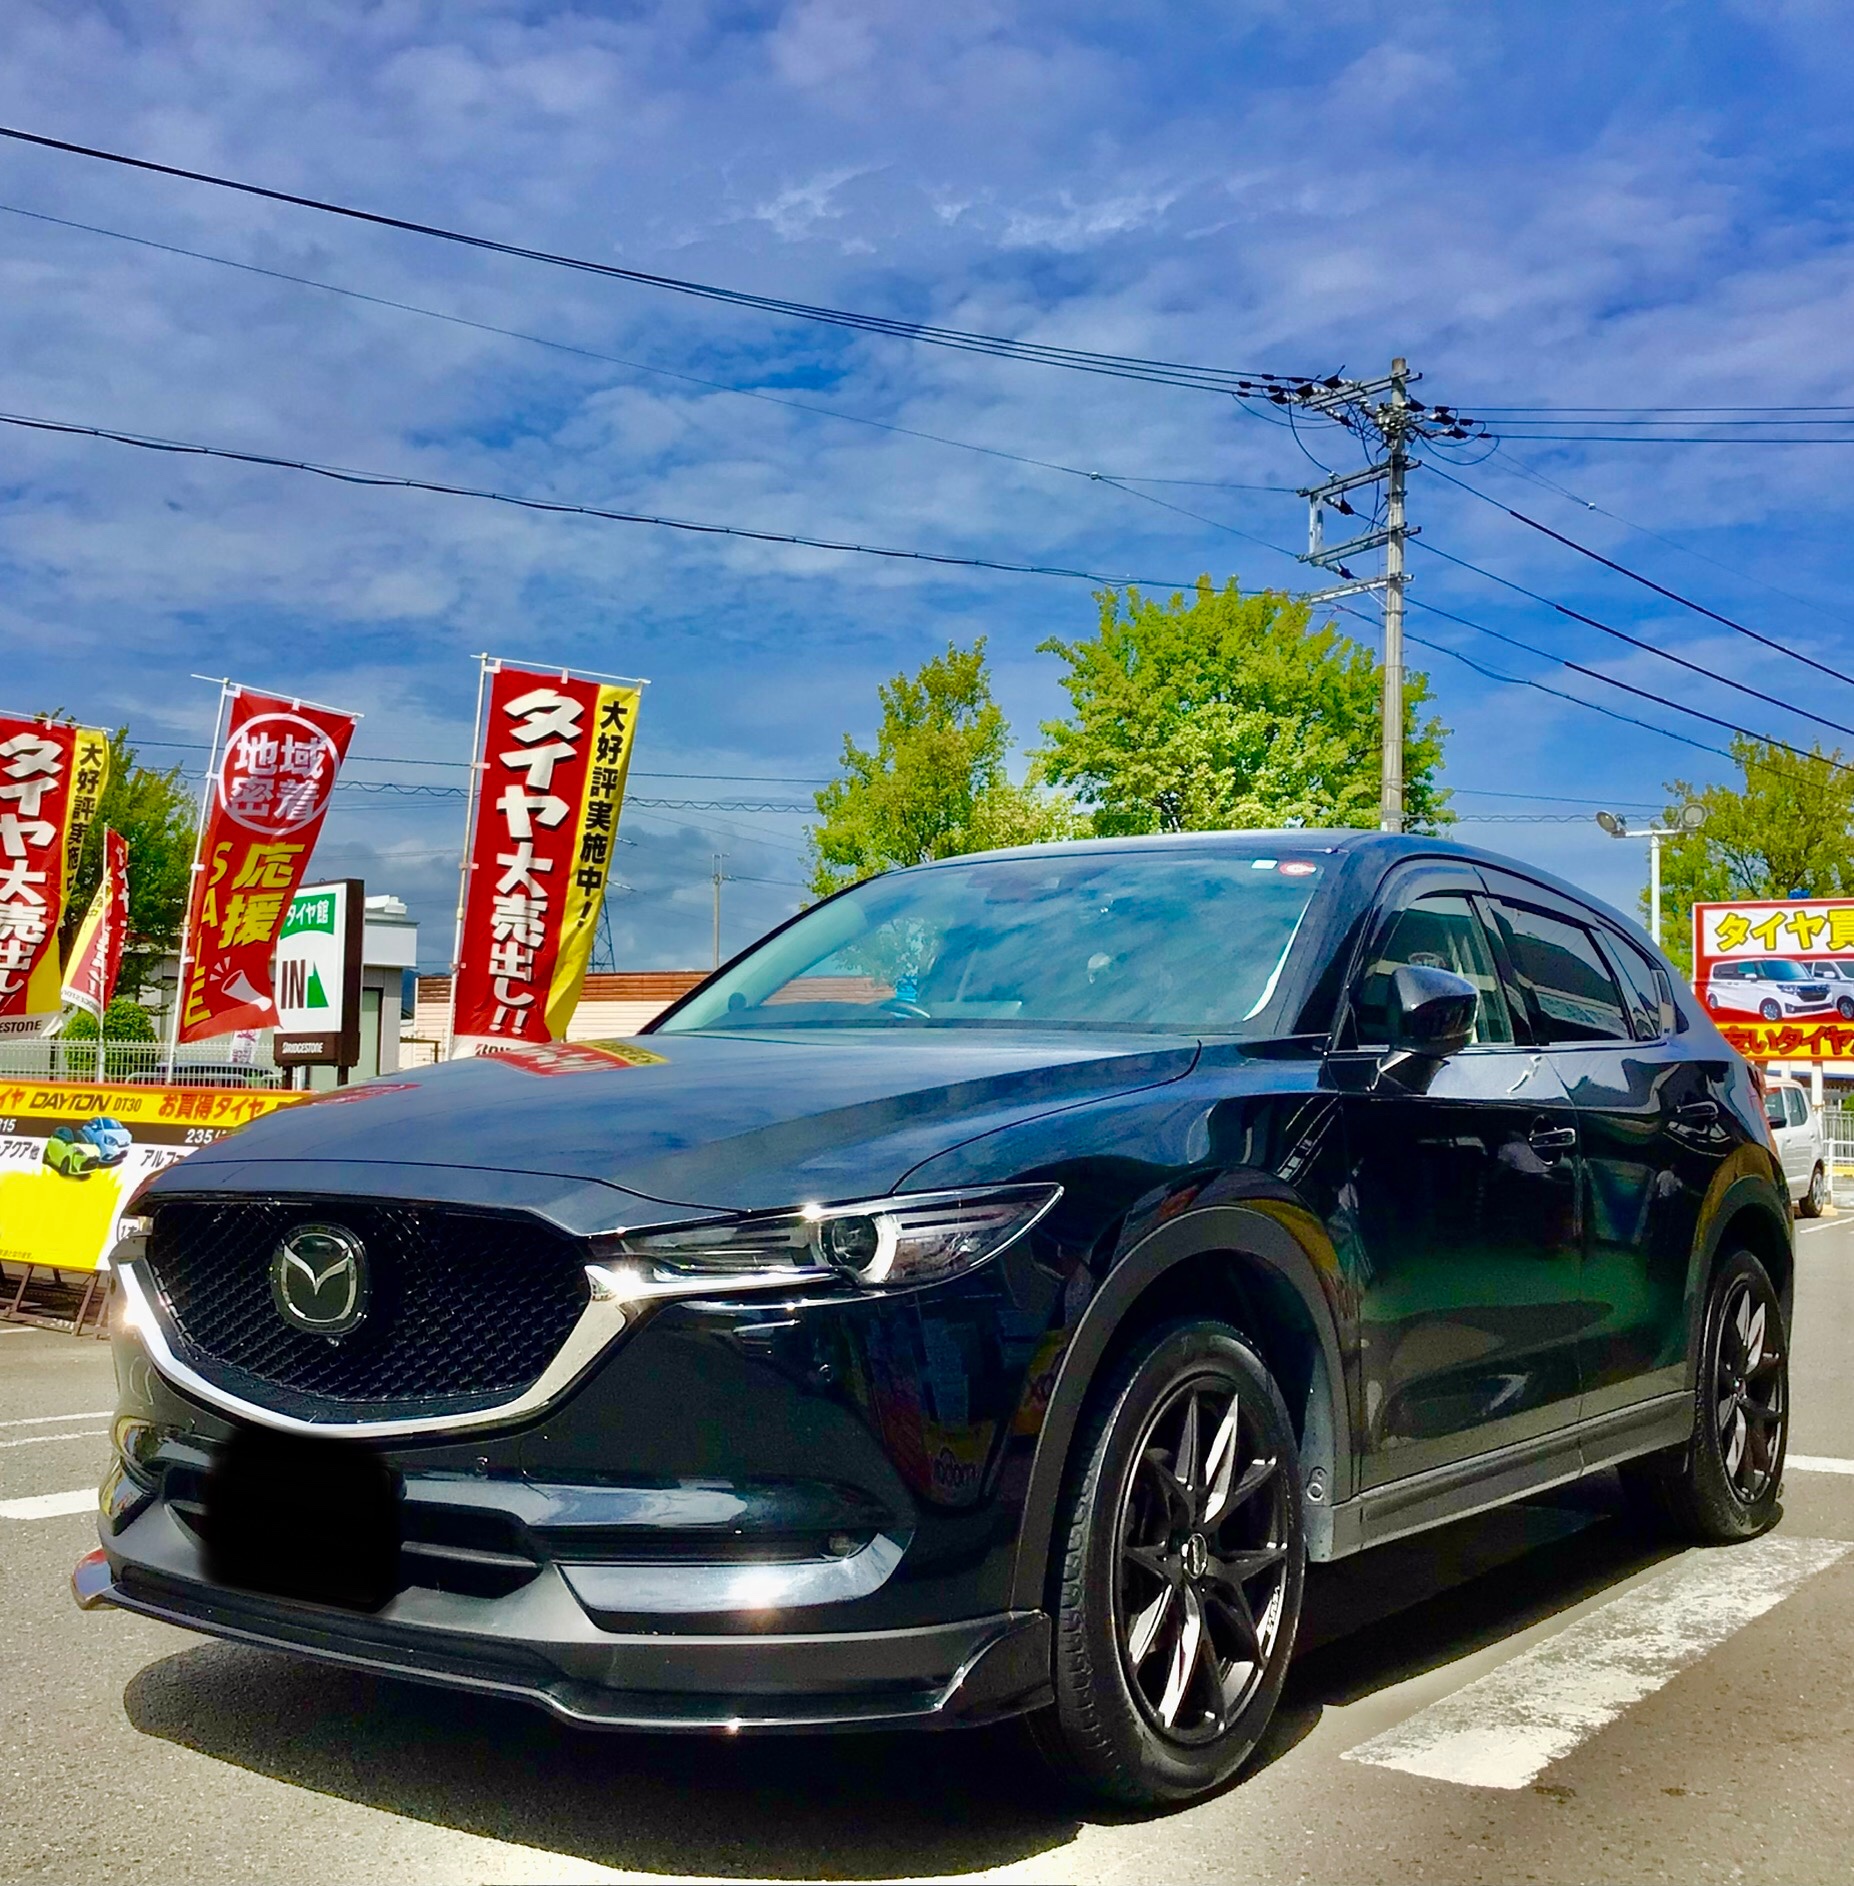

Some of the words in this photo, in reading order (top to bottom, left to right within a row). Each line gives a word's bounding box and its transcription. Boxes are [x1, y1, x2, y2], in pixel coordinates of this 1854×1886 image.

[234, 731, 327, 779] 地域
[230, 774, 320, 821] 密着
[576, 700, 628, 928] 大好評実施中!
[489, 688, 585, 1034] タイヤ大売出し!!
[218, 841, 306, 949] 応援
[287, 899, 329, 927] タイヤ館
[281, 959, 306, 1010] IN
[1719, 1025, 1854, 1055] 安いタイヤ
[29, 1092, 112, 1112] DAYTON
[113, 1096, 143, 1112] DT30
[158, 1094, 265, 1121] お買得タイヤ
